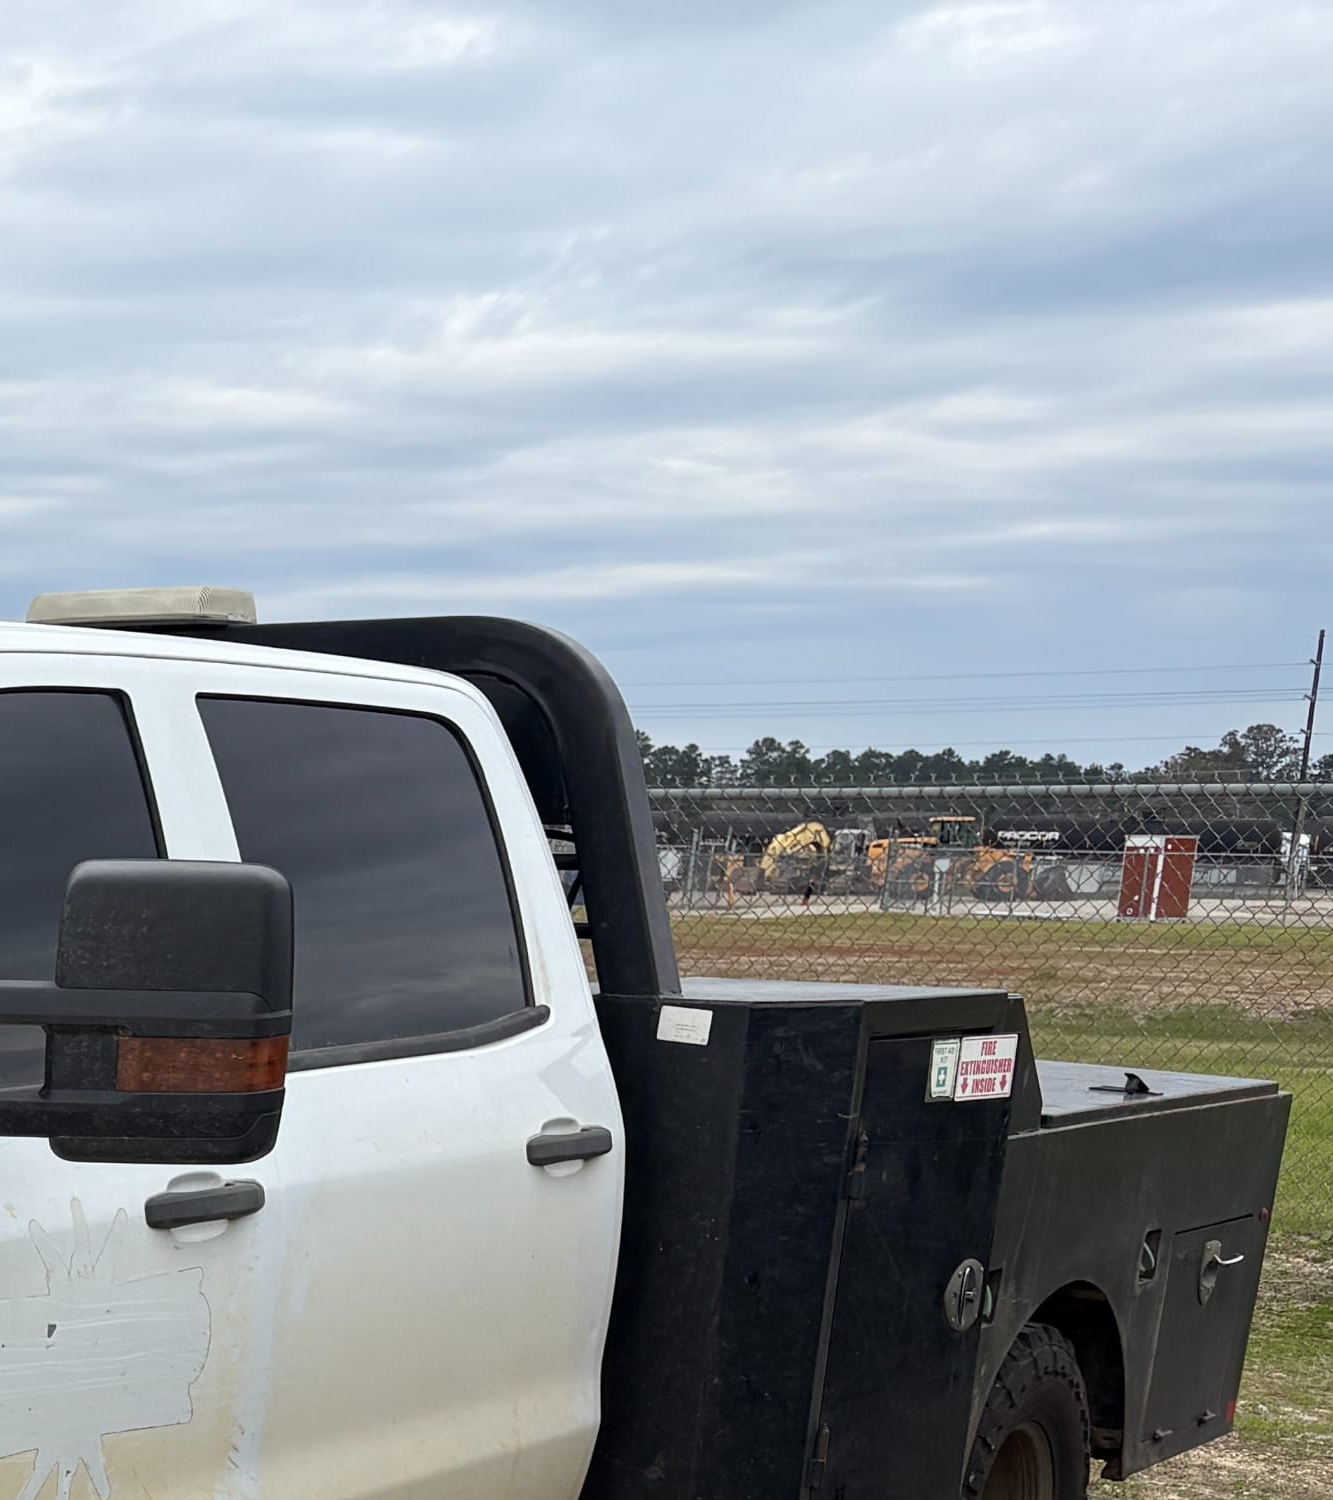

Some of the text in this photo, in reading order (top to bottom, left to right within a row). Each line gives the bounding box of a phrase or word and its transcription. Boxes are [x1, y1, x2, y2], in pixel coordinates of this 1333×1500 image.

[980, 1041, 998, 1057] FIRE
[960, 1058, 1013, 1076] EXTINGUISHER
[971, 1077, 997, 1094] INSIDE
